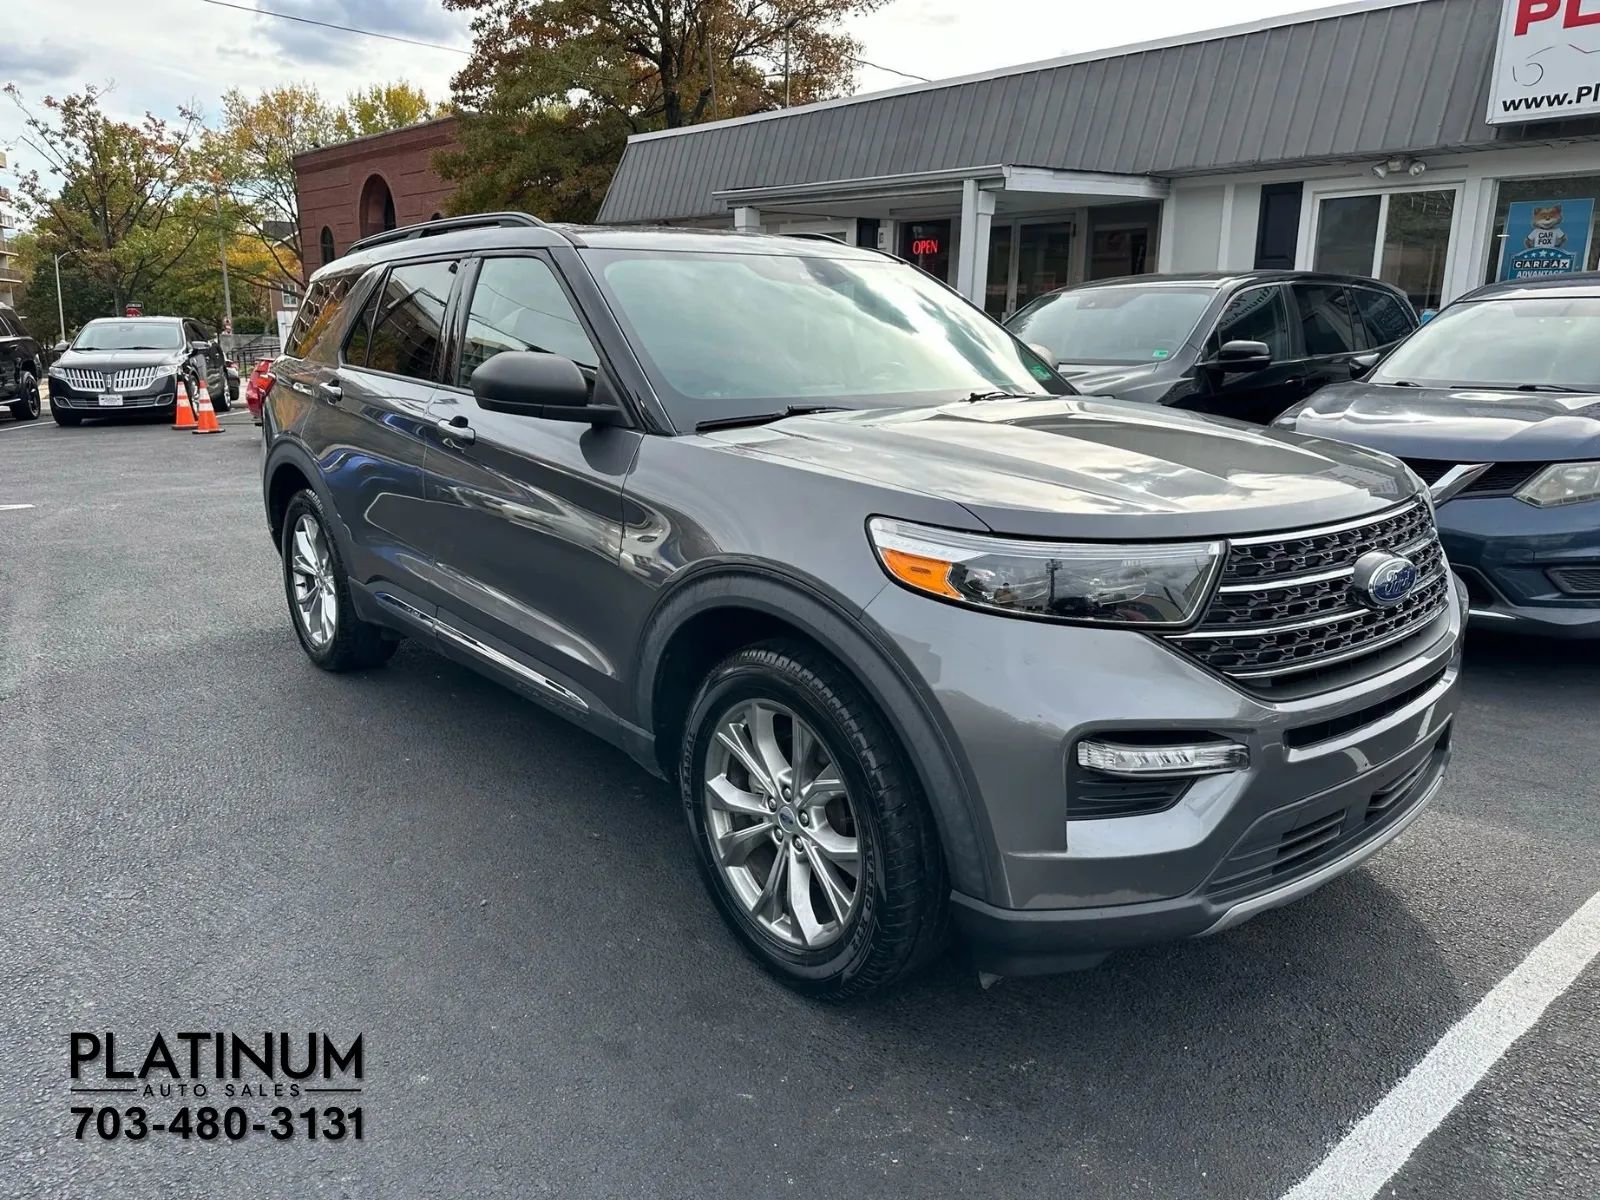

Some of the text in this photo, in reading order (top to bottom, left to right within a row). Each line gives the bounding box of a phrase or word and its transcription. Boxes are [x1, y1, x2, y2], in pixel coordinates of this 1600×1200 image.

[1538, 231, 1554, 239] CAR
[912, 239, 938, 255] OPEN
[1515, 260, 1569, 269] CARFAX
[1384, 568, 1411, 595] Ford
